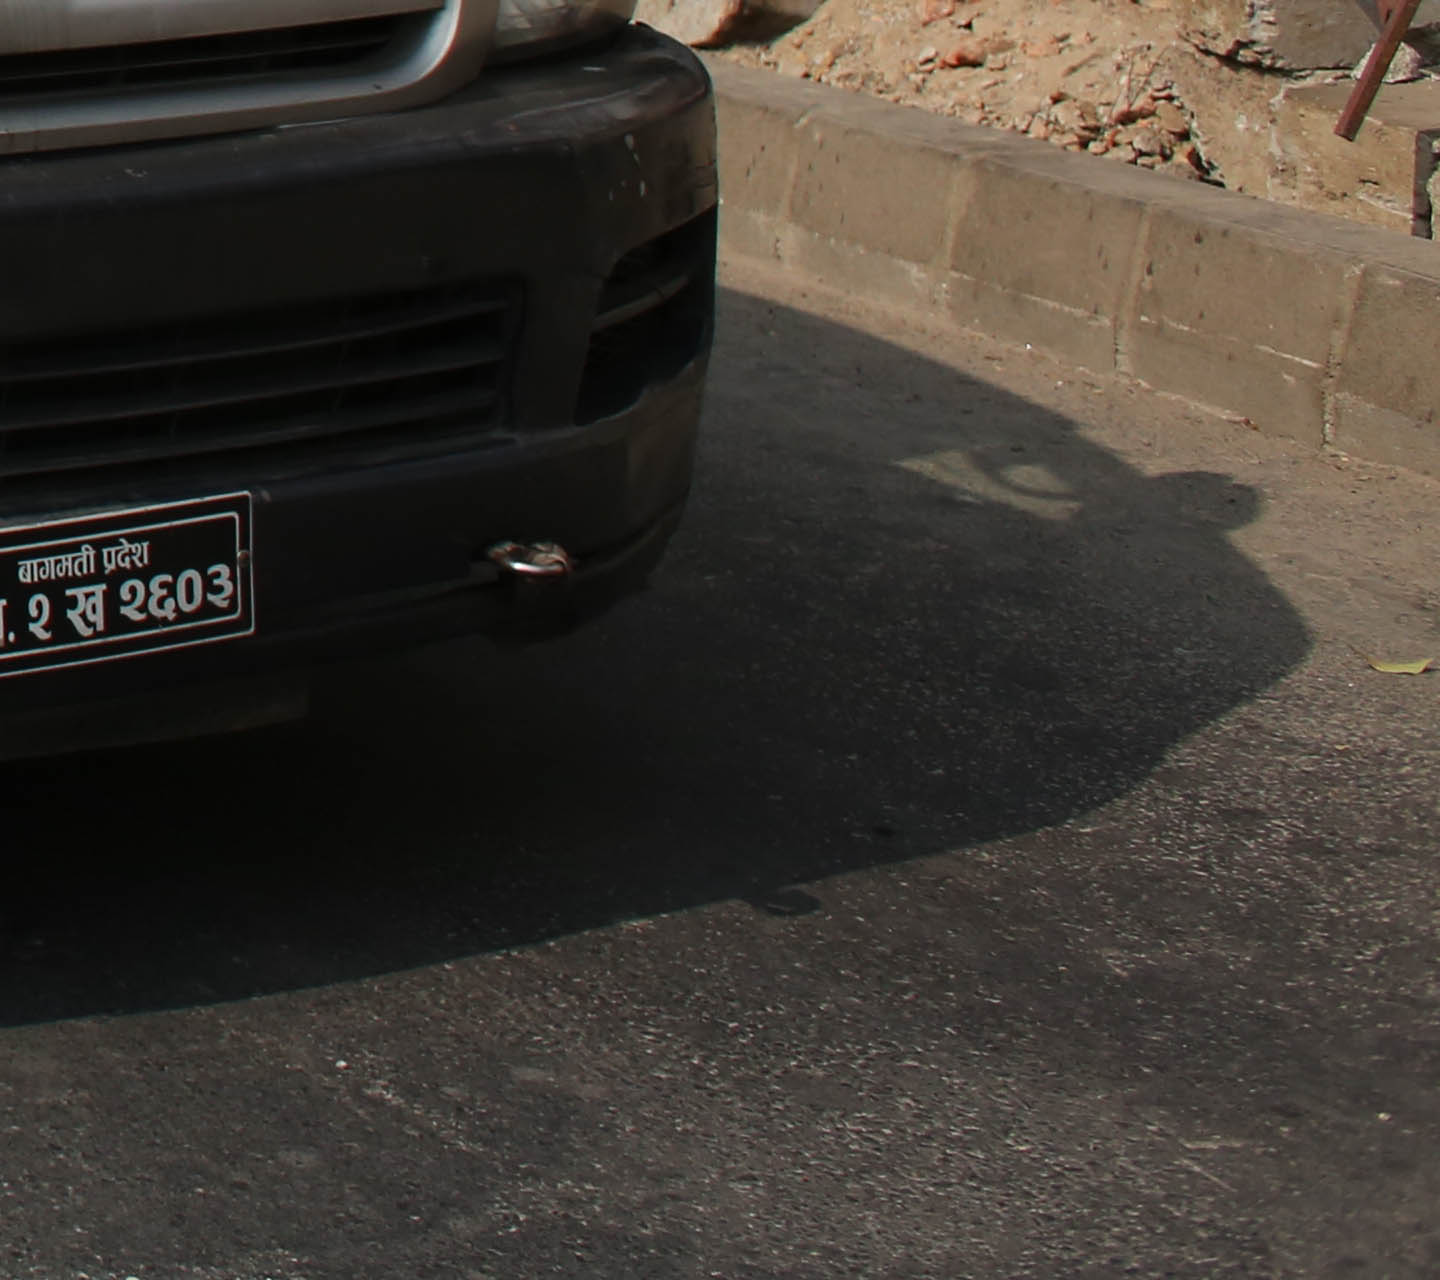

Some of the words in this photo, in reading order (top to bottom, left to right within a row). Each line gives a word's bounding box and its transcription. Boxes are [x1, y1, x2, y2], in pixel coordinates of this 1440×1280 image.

[18, 545, 96, 584] बागमती
[102, 538, 151, 573] प्रदेश
[28, 593, 51, 640] २
[66, 583, 107, 636] ख
[120, 563, 234, 621] २६०३
